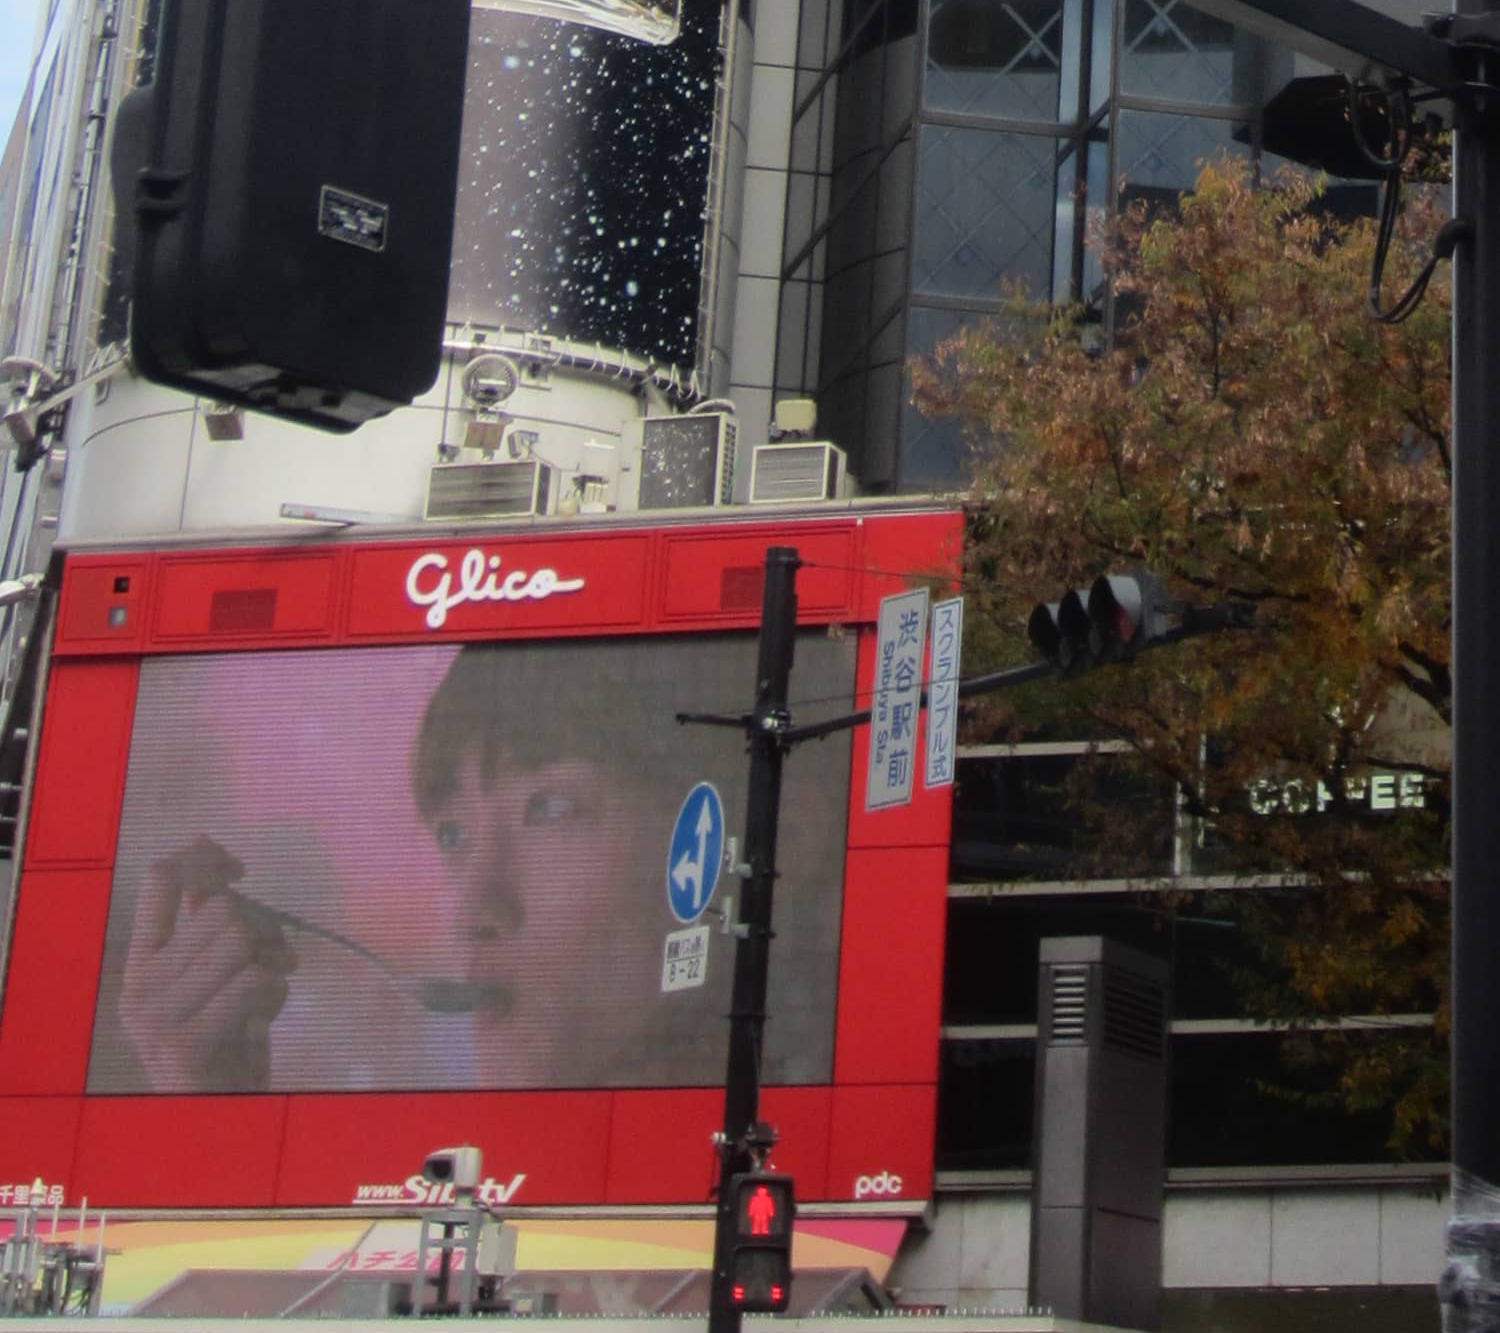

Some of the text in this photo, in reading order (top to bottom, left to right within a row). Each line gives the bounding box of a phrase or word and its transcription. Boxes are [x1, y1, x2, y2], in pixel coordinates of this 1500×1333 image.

[406, 548, 585, 629] Glico
[878, 640, 896, 722] Shibuya
[887, 608, 920, 787] 渋谷駅前
[855, 1170, 903, 1199] pdc
